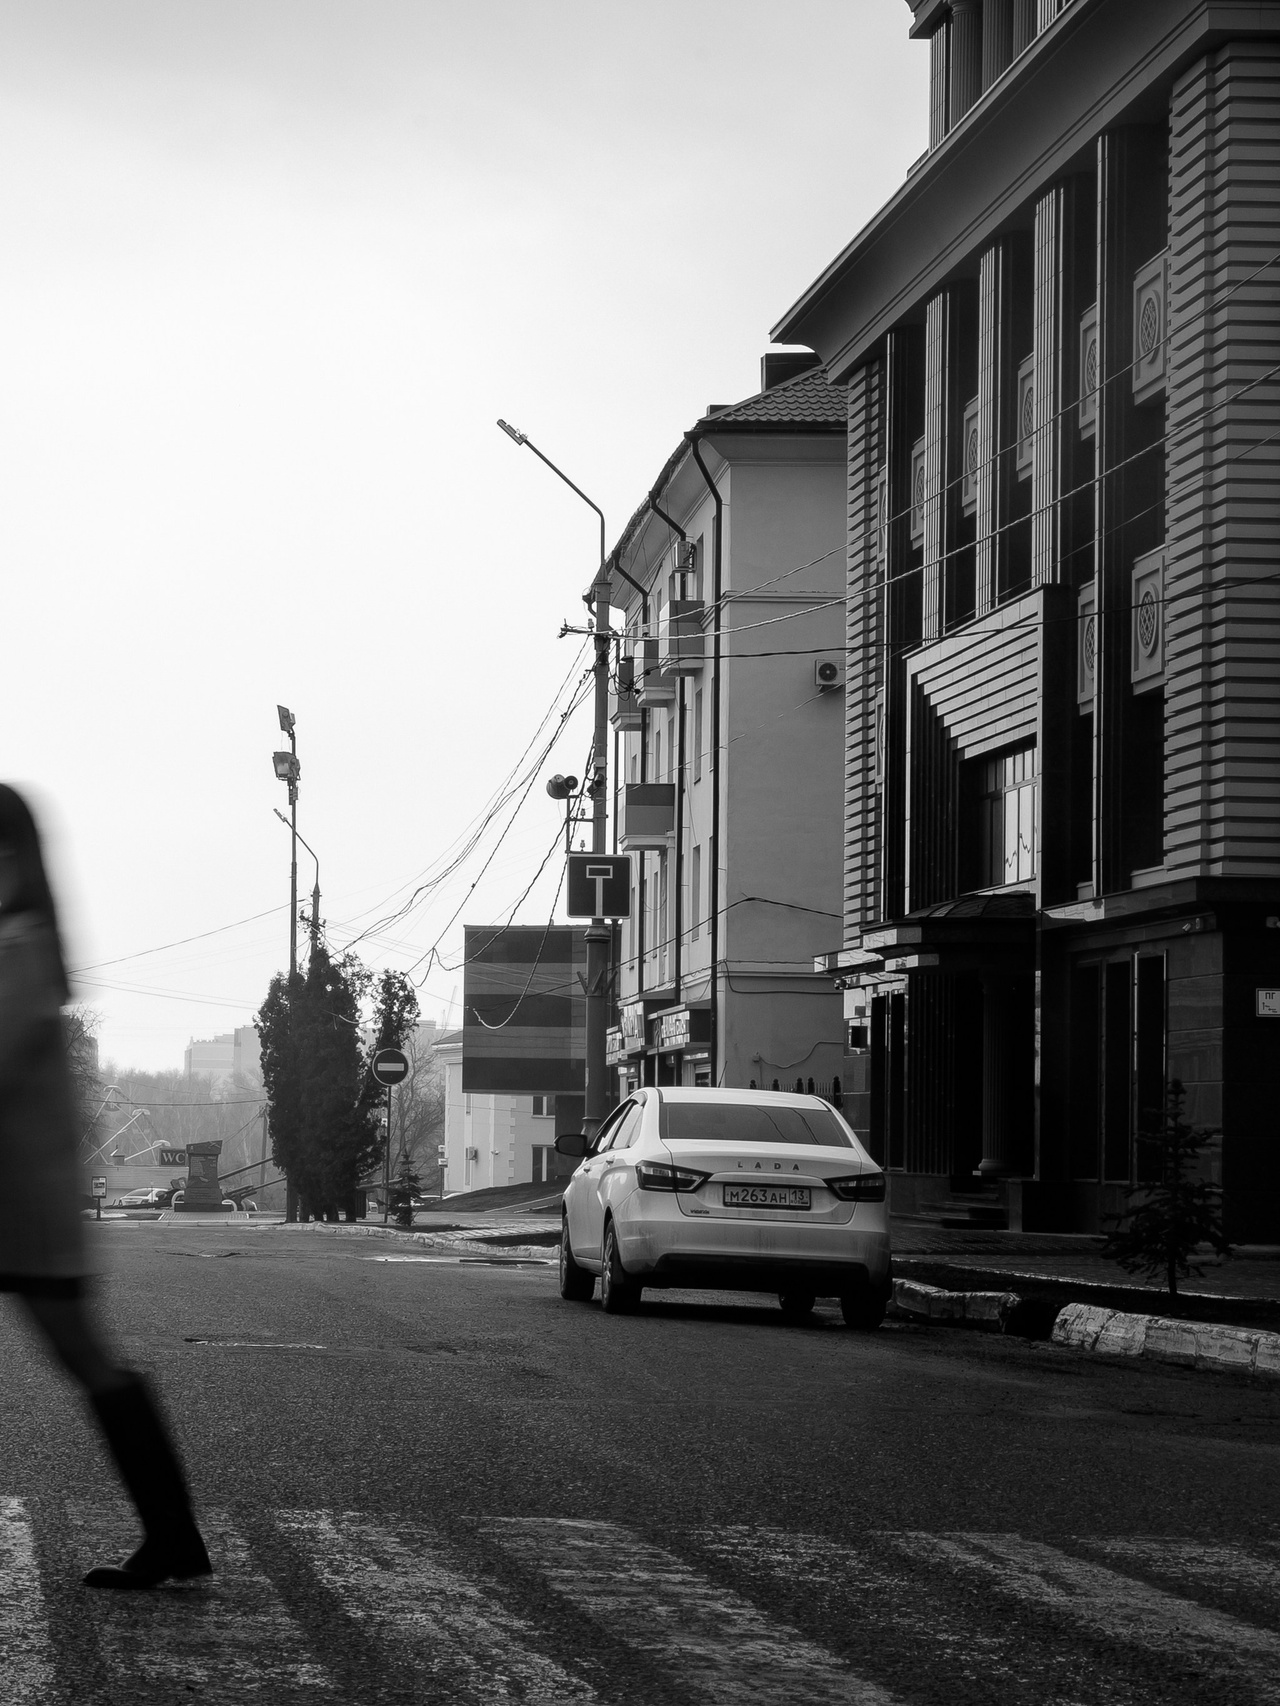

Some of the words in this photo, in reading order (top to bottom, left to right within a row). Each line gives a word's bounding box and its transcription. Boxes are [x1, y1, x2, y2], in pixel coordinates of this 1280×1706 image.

[162, 1153, 185, 1163] WC
[738, 1161, 800, 1171] LADA
[791, 1190, 804, 1200] 13
